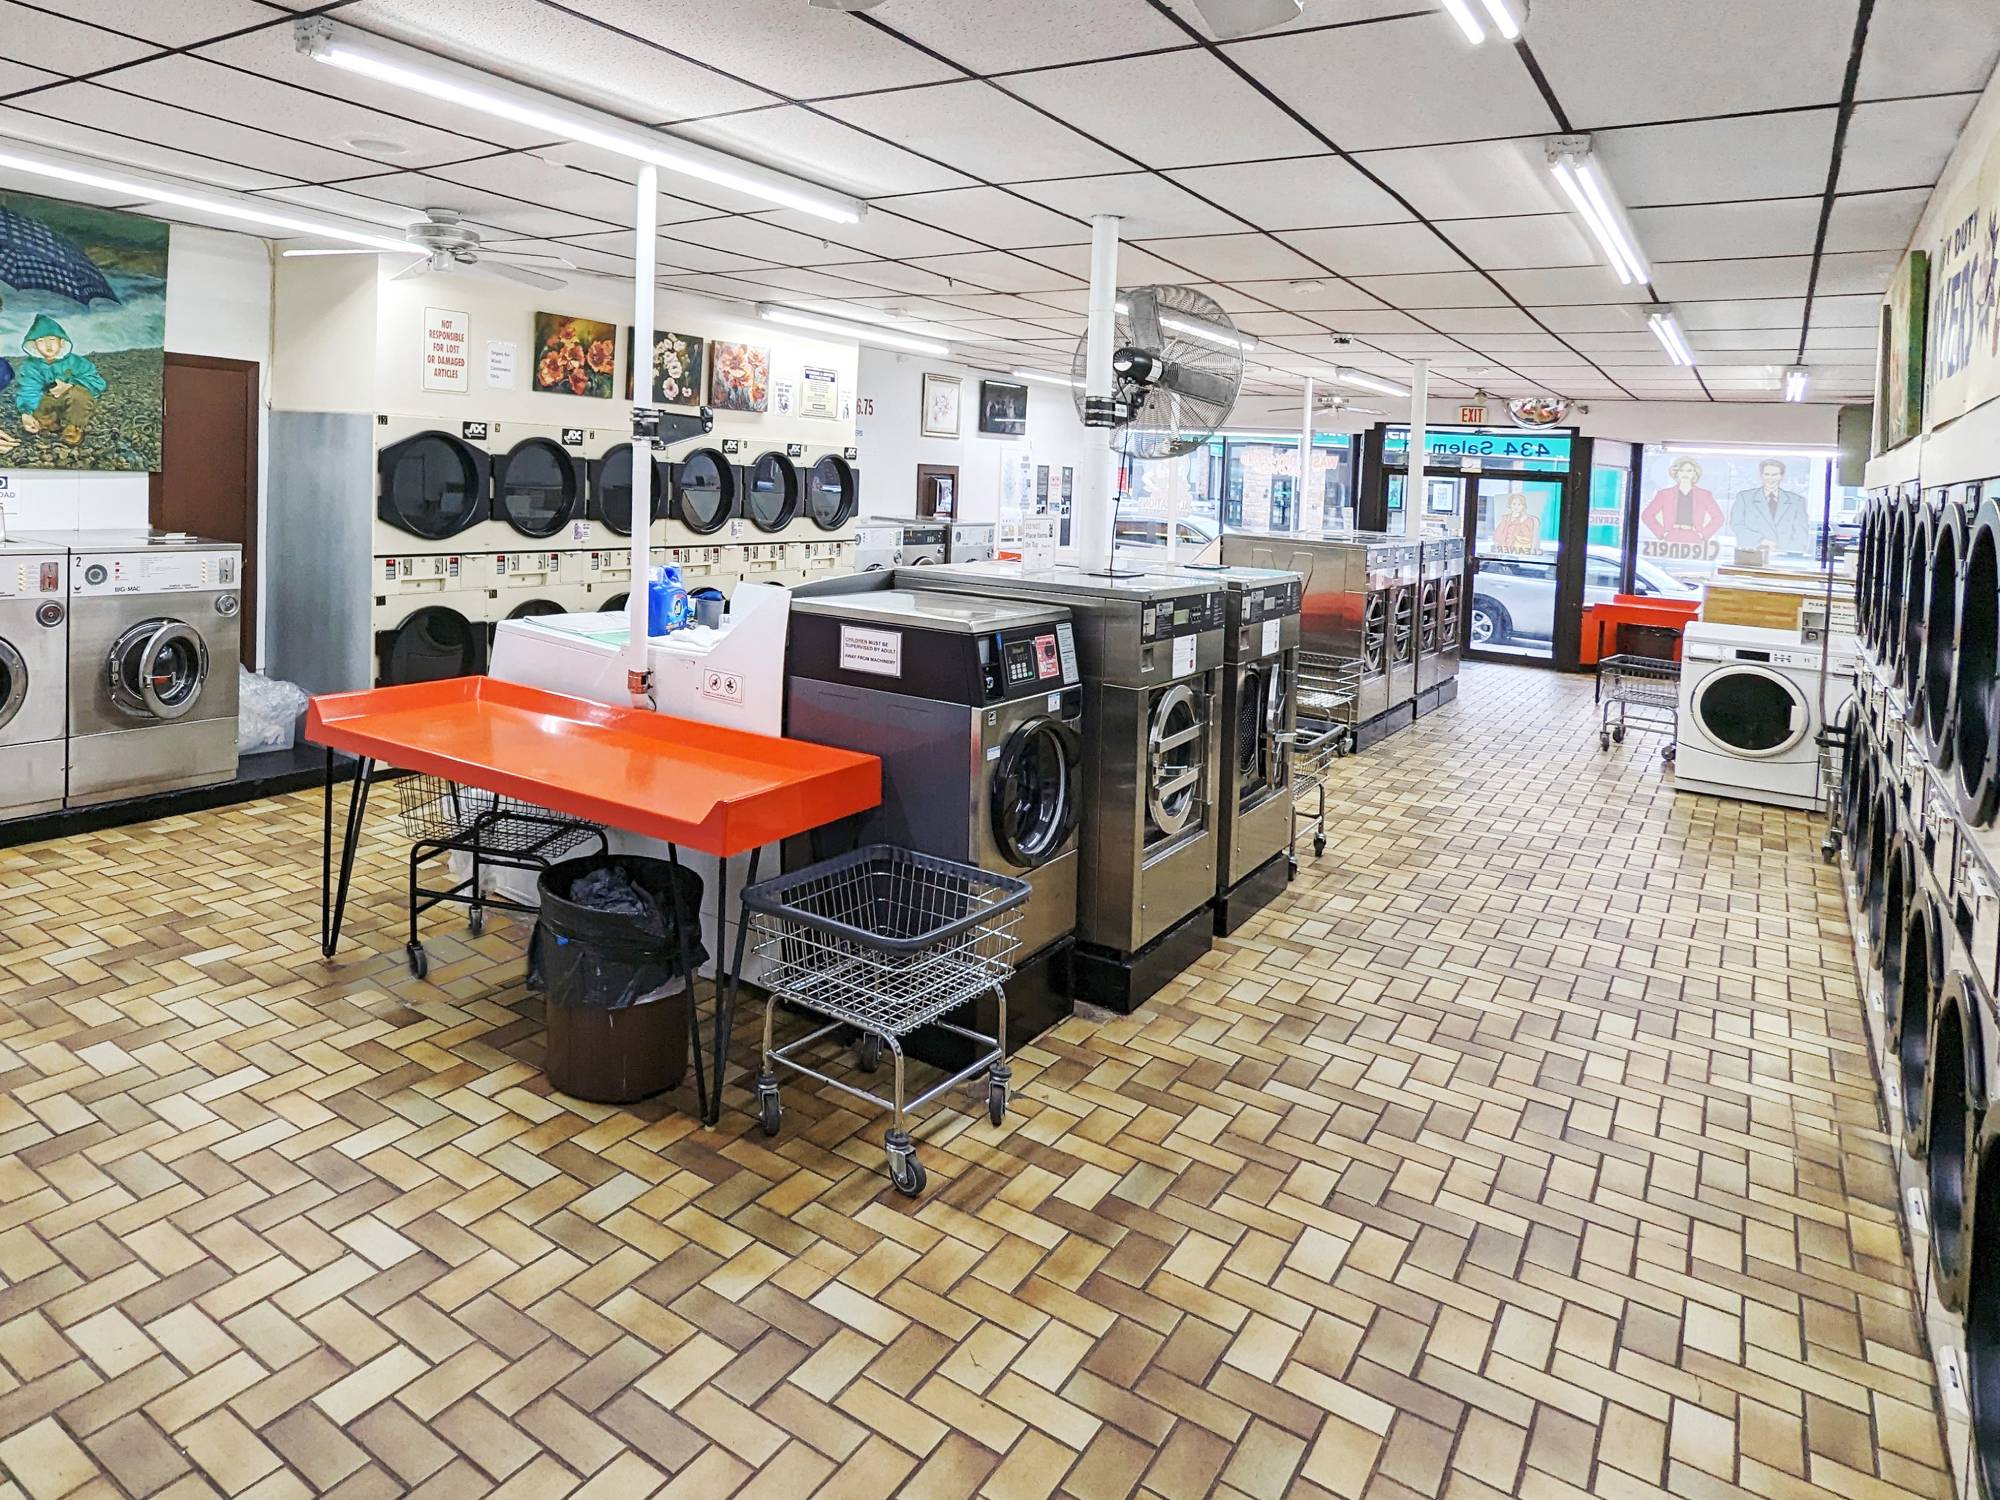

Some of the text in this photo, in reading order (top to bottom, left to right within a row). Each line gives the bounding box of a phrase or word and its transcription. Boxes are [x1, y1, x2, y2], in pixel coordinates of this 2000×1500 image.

[1954, 207, 1979, 256] DUTY
[441, 319, 453, 329] NOT
[428, 329, 465, 342] RESPONSIBLE
[433, 342, 460, 354] FOR LOST
[427, 354, 465, 367] OR DAMAGED
[433, 367, 459, 379] ARTICLES
[856, 397, 874, 416] 6.75
[1461, 407, 1484, 423] EXIT
[76, 556, 82, 567] 2
[845, 643, 874, 651] SUPERVISED
[870, 657, 896, 665] MACHINERY
